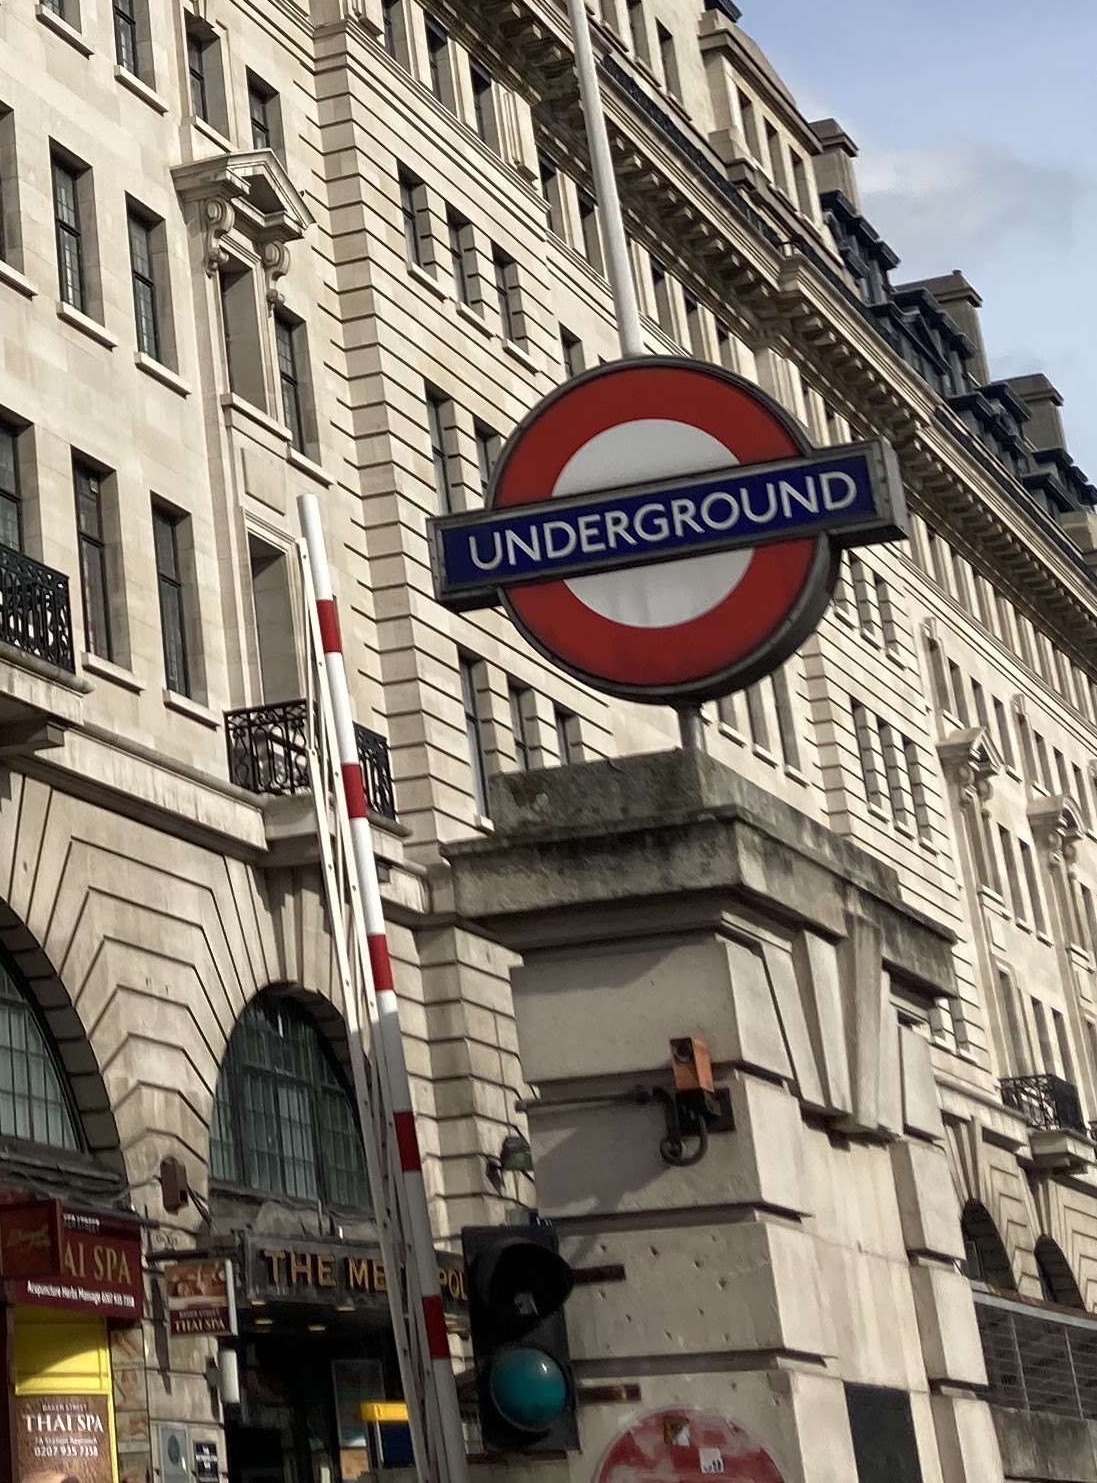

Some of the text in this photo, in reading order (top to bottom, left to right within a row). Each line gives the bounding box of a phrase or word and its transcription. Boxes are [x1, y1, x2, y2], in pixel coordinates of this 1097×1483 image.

[468, 469, 857, 571] UNDERGROUND
[64, 1241, 132, 1286] AI SPA
[264, 1249, 337, 1287] THE
[174, 1317, 226, 1333] THAI SPA
[42, 1403, 87, 1412] BAKER STREET
[23, 1413, 104, 1433] THAI SPA
[34, 1445, 58, 1457] 0207
